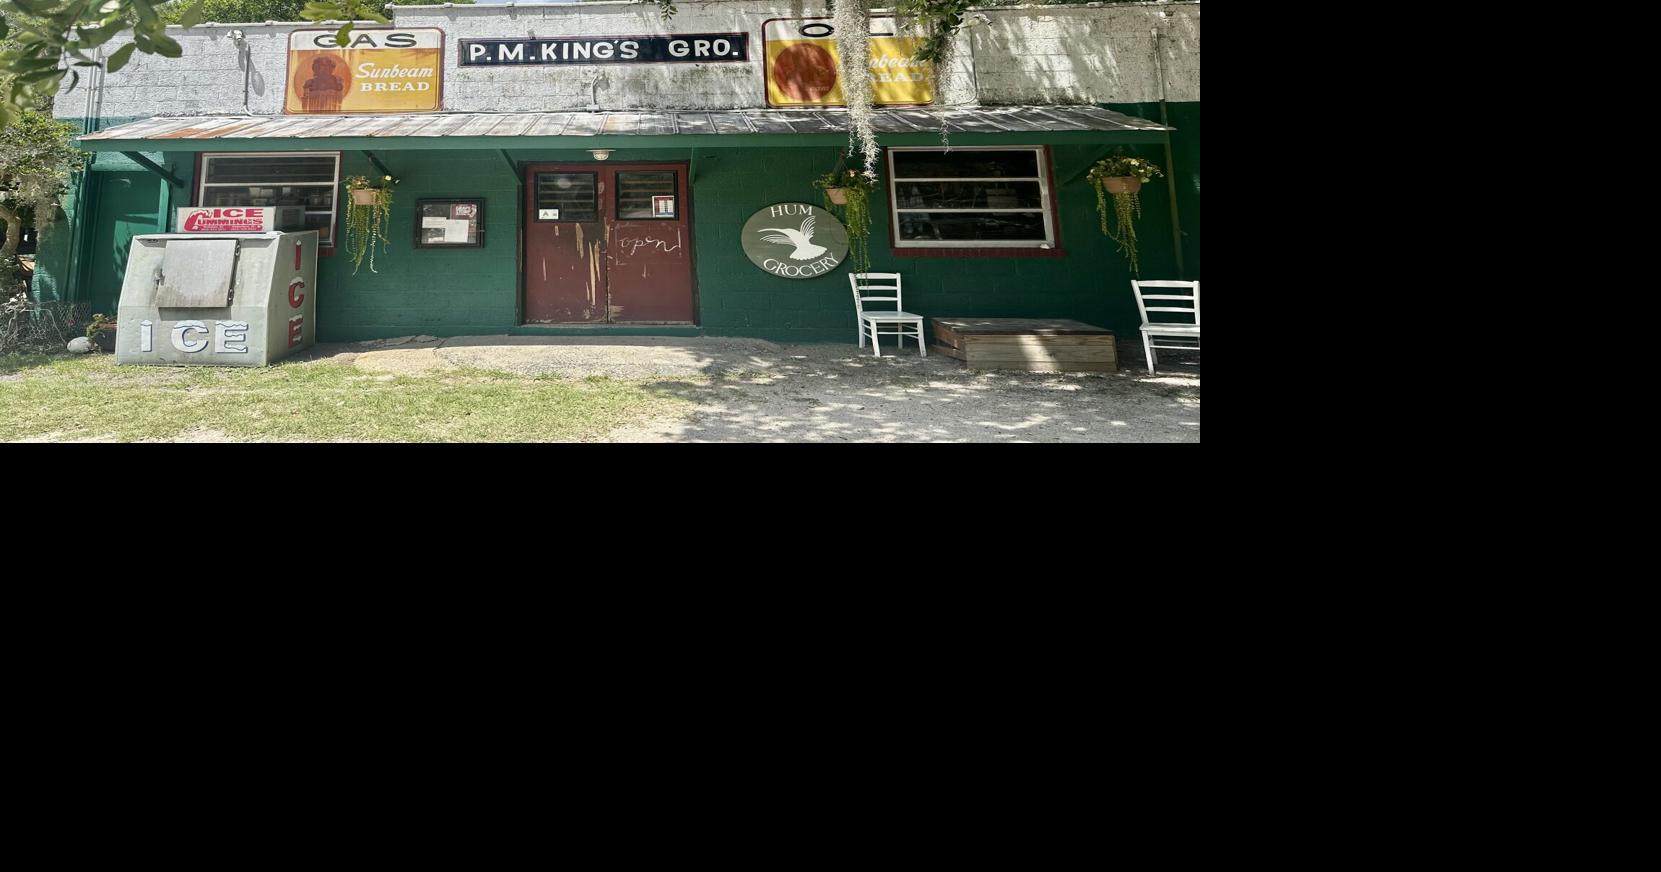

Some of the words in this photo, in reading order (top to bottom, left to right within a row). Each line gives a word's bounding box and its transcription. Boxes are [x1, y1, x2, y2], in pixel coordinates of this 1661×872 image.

[313, 32, 417, 48] GAS
[668, 38, 739, 57] GRO.
[355, 62, 433, 79] Sunbeam
[360, 81, 430, 92] BREAD
[213, 208, 263, 218] ICE
[770, 204, 813, 218] HUM
[763, 252, 839, 277] GROCERY
[288, 239, 305, 349] ICE
[140, 319, 249, 353] ICE
